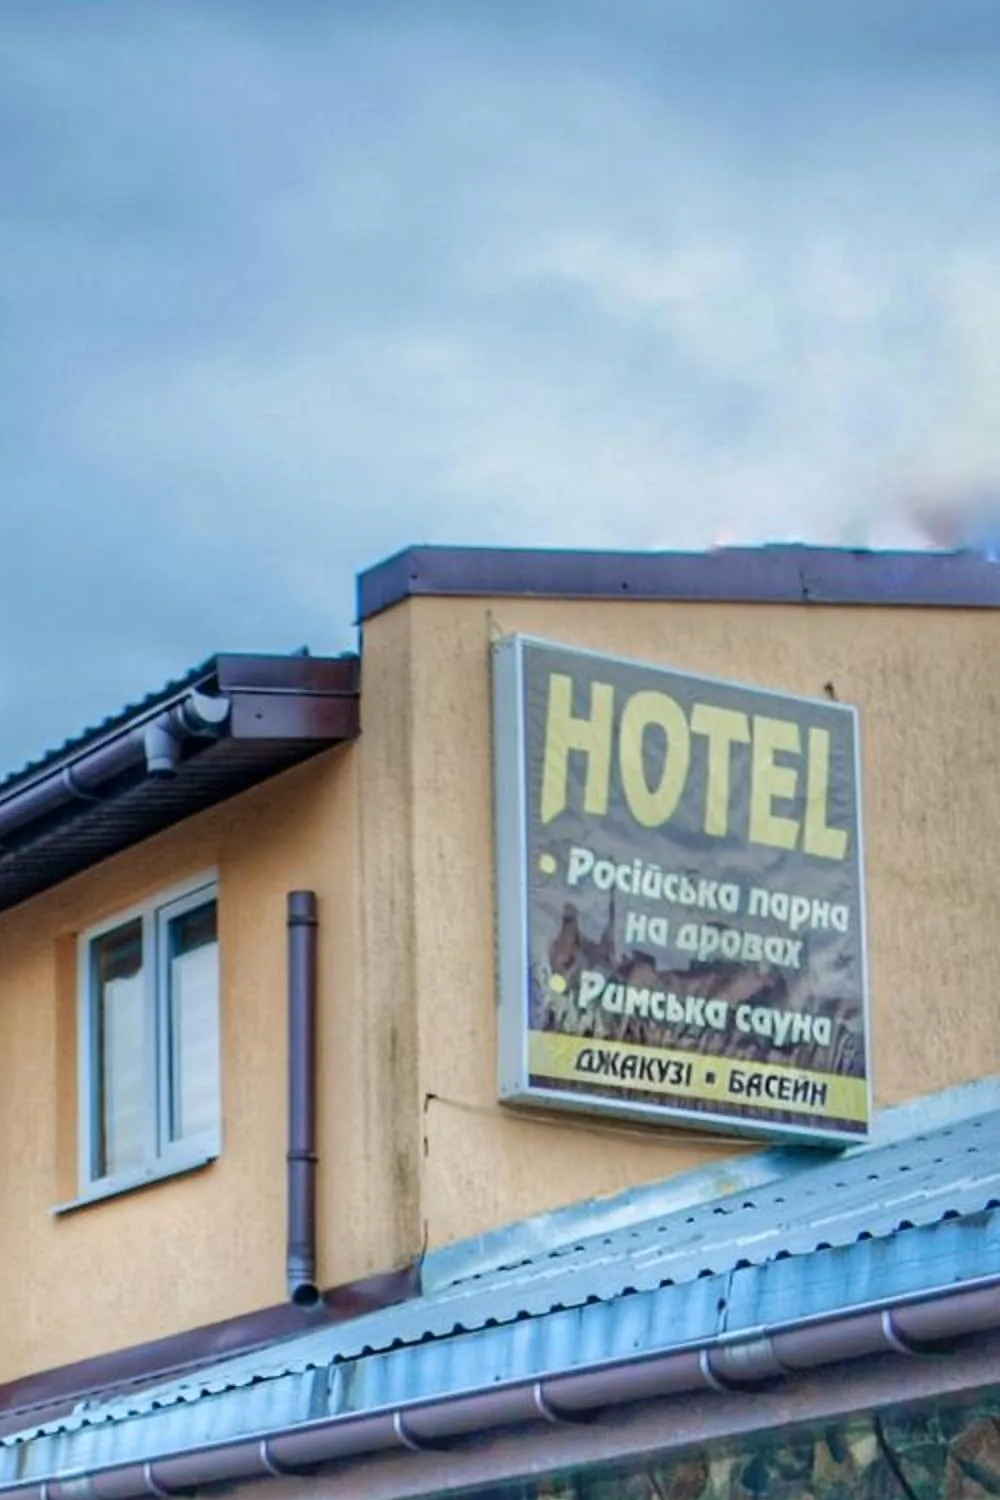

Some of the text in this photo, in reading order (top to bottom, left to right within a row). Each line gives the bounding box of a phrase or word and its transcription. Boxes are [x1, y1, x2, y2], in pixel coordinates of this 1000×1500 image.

[541, 673, 848, 860] HOTEL
[567, 847, 849, 932] Російська парна
[625, 912, 804, 969] на дровах
[578, 970, 833, 1046] Римська сауна
[574, 1048, 693, 1087] ДЖАКУЗІ
